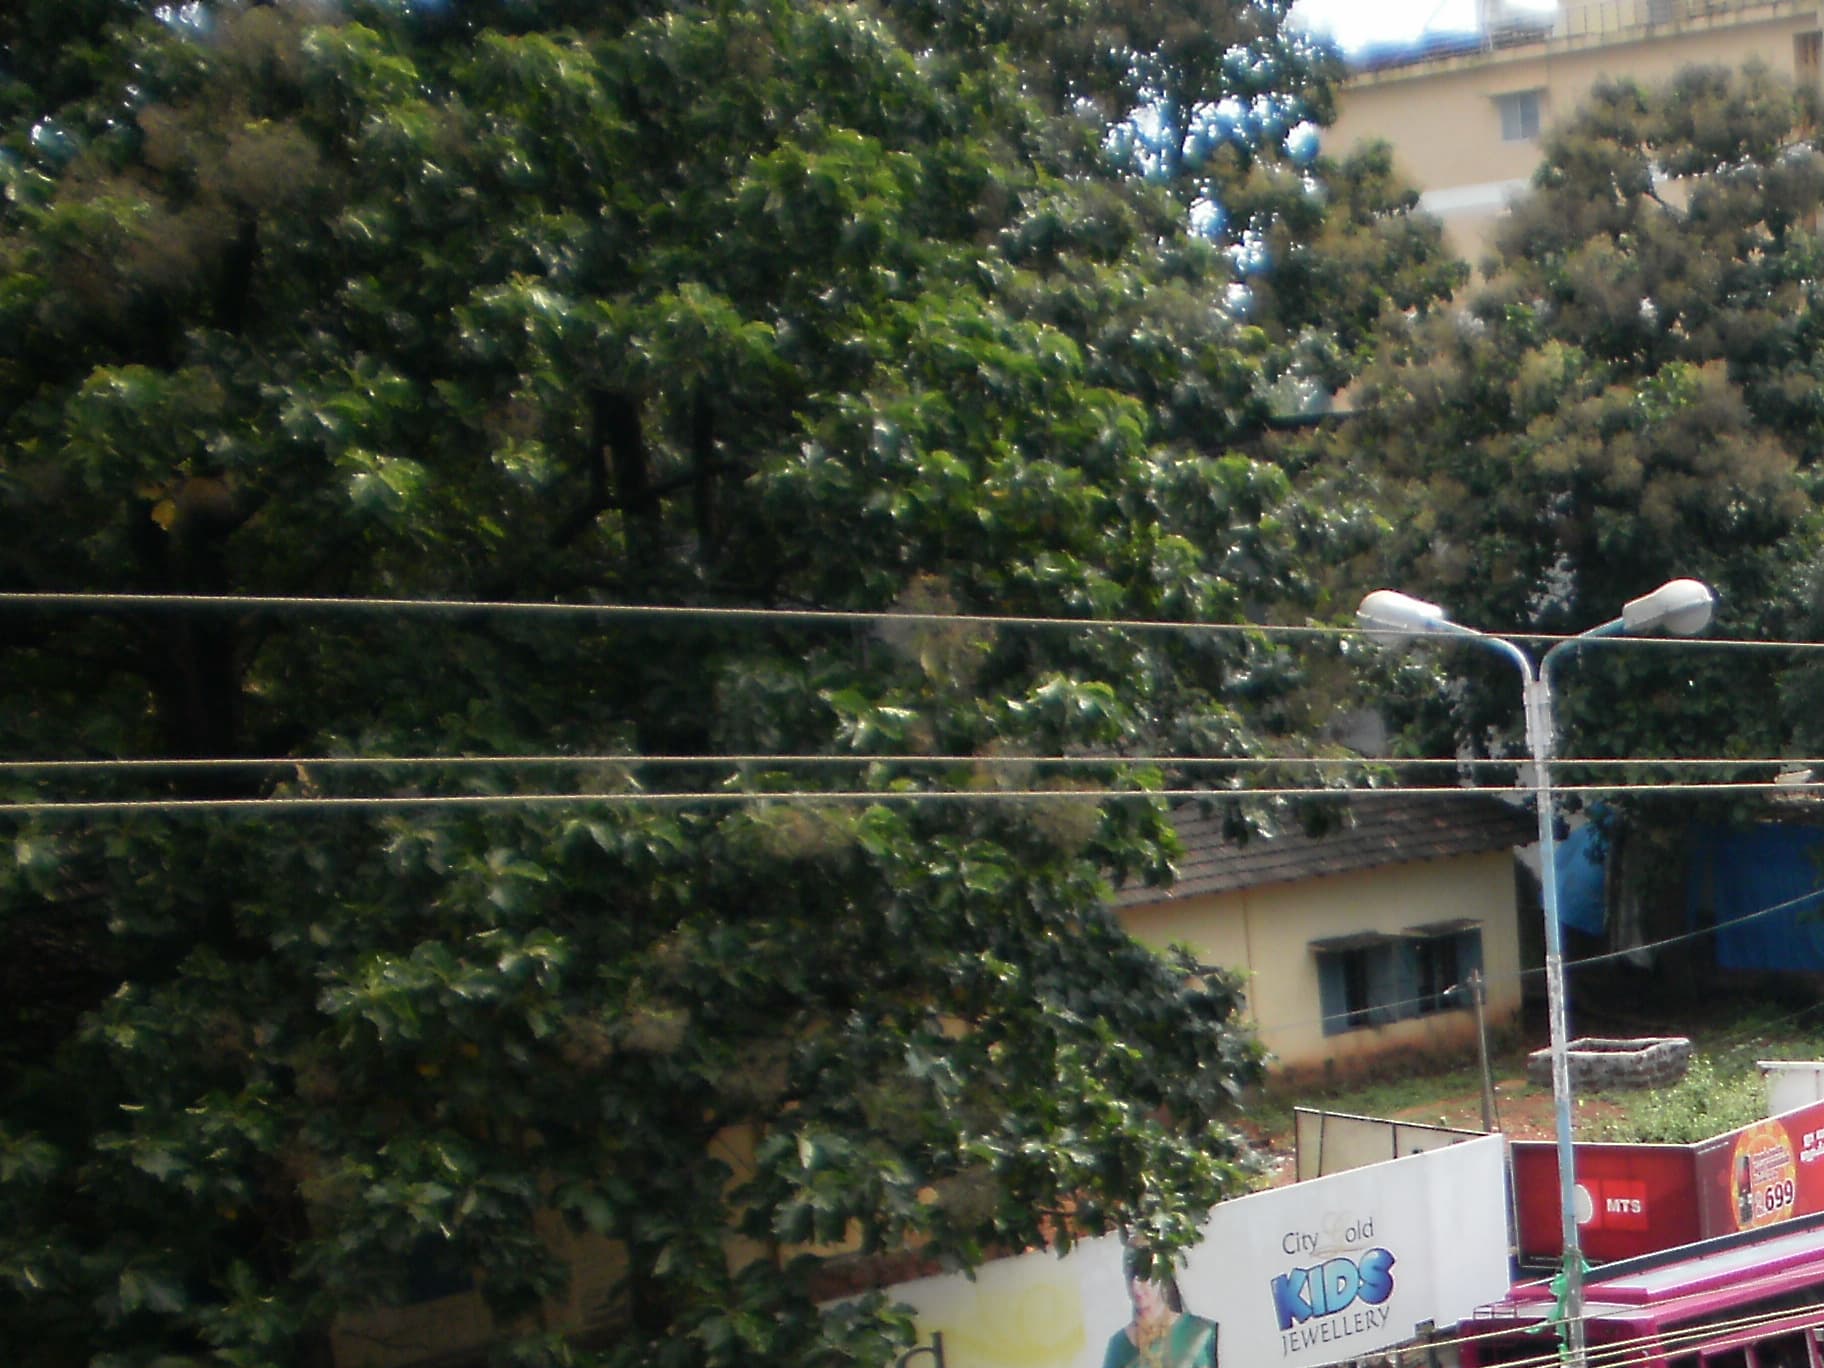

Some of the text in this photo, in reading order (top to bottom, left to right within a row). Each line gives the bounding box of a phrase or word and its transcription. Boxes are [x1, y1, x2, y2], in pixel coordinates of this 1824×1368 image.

[1606, 1198, 1642, 1213] MTS
[1764, 1180, 1794, 1212] 699
[1282, 1231, 1319, 1256] City
[1270, 1246, 1396, 1332] KIDS
[1281, 1306, 1391, 1358] JEWELLERY
